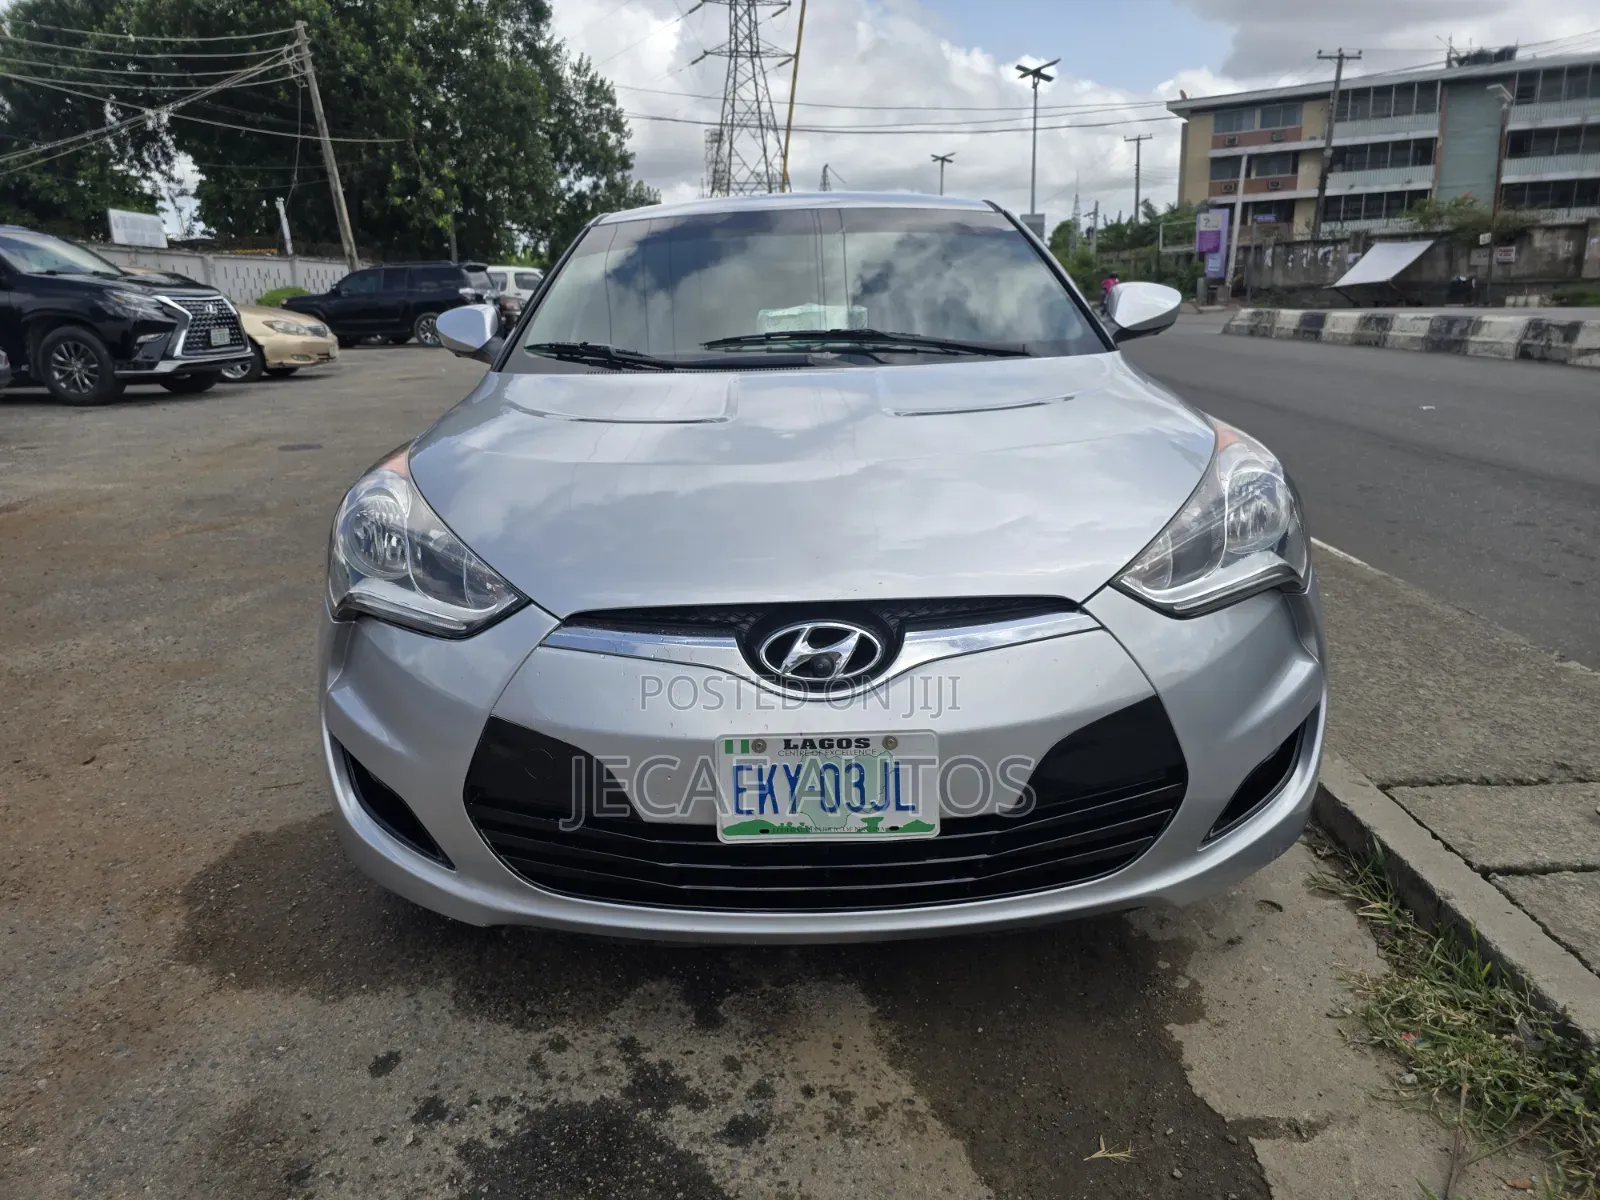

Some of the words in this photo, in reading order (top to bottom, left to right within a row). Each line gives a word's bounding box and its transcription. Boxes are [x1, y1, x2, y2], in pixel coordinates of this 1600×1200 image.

[783, 737, 871, 750] LAGOS
[777, 749, 808, 757] CENTRE
[811, 749, 822, 757] OF
[825, 748, 877, 757] EXCELLENCE
